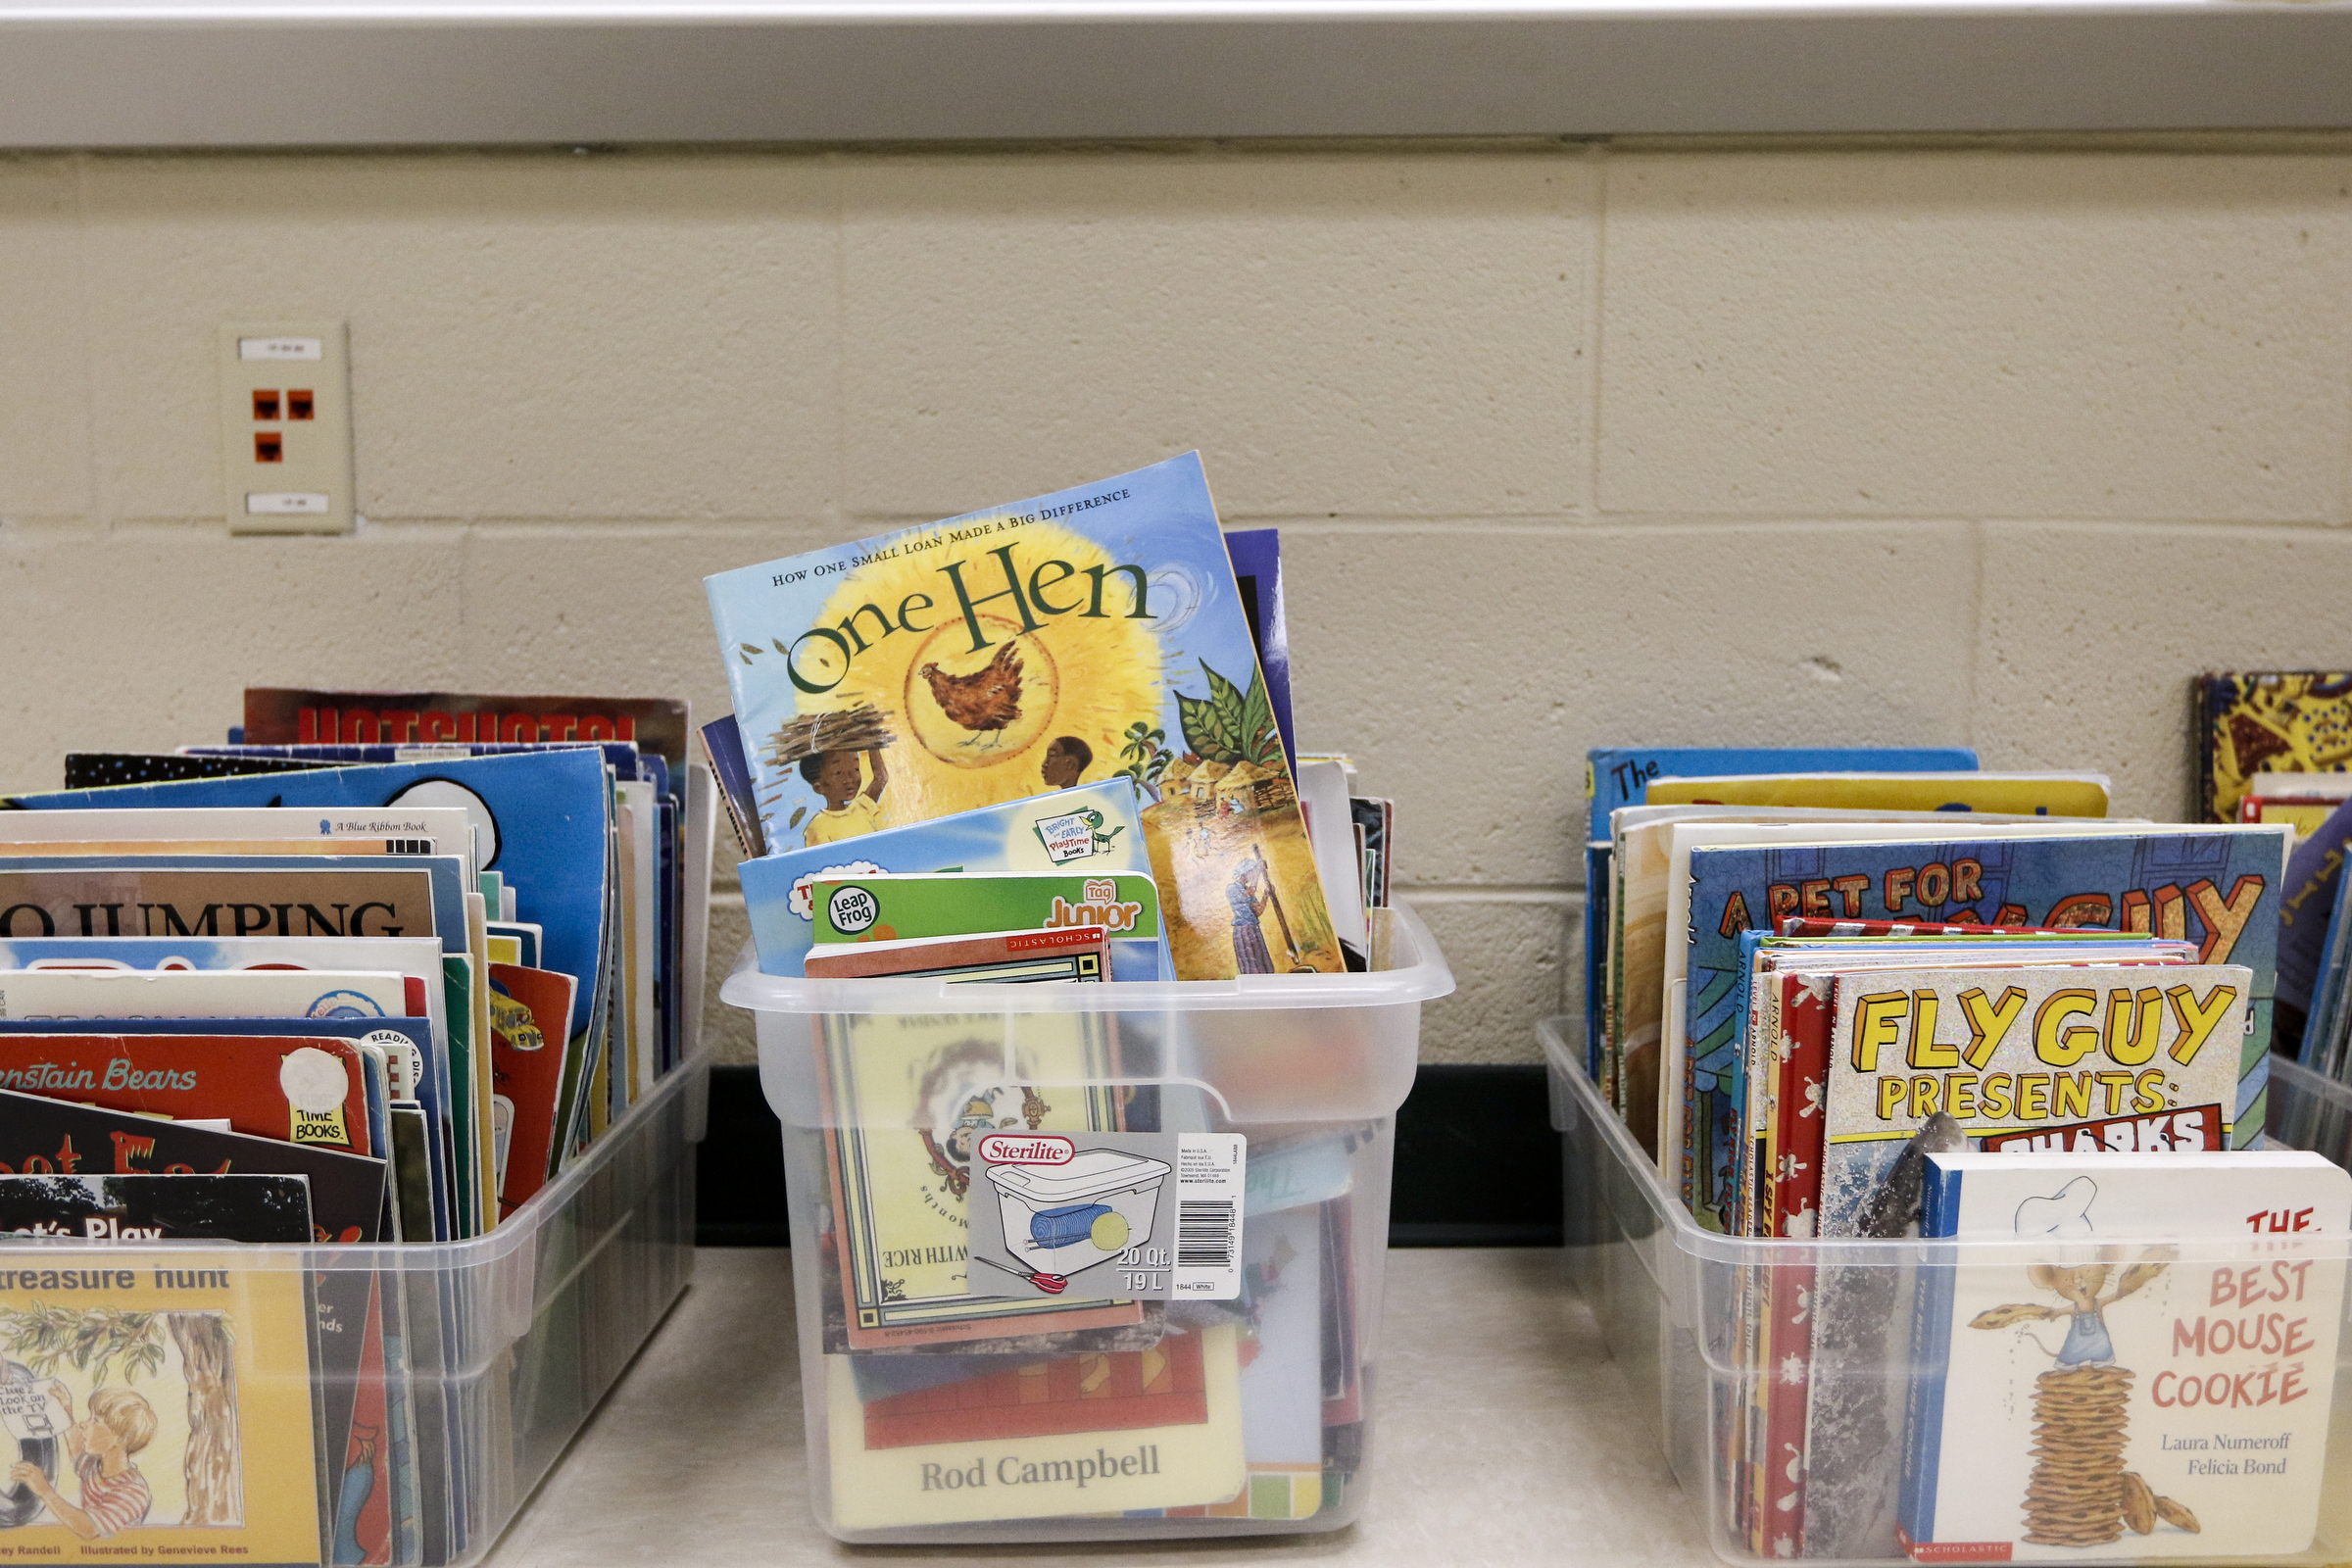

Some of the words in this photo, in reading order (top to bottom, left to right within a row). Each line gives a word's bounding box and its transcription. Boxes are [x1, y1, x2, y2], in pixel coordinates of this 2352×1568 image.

[772, 569, 808, 587] HOW
[813, 561, 847, 577] ONE
[852, 549, 900, 568] SMALL
[905, 537, 945, 555] LOAN
[949, 523, 993, 544] MADE
[996, 522, 1005, 532] A
[1009, 514, 1036, 528] BIG
[1040, 488, 1131, 521] DIFFERENCE
[786, 591, 935, 694] One
[936, 541, 1157, 654] Hen
[1611, 760, 1659, 801] The
[346, 821, 367, 832] Blue
[368, 821, 401, 832] Ribbon
[403, 821, 428, 832] Book
[1045, 817, 1074, 834] BRIGHT
[1061, 826, 1084, 839] EARLY
[834, 892, 867, 912] Leap
[1089, 886, 1110, 899] Tag
[1718, 890, 1753, 939] A
[1768, 873, 1869, 919] PET
[1885, 858, 1984, 912] FOR
[839, 906, 873, 926] Frog
[1046, 899, 1139, 928] Junior
[1009, 933, 1090, 949] SCHOLASTIC
[1736, 949, 1747, 1013] ARNOLD
[1769, 993, 1781, 1061] ARNOLD
[1851, 985, 2027, 1072] FLY
[2032, 984, 2237, 1066] GUY
[102, 1057, 197, 1091] Bears
[1877, 1069, 2179, 1121] PRESENTS:
[296, 1123, 340, 1139] BOOKS
[989, 1140, 1063, 1160] Sterilite
[1764, 1186, 1773, 1221] SPY
[883, 1248, 921, 1268] RICE
[925, 1244, 968, 1265] WITH
[1116, 1248, 1143, 1266] 20
[1146, 1248, 1171, 1267] Qt.
[154, 1263, 230, 1290] hunt
[1126, 1273, 1147, 1291] 19
[1152, 1273, 1163, 1291] L
[2209, 1258, 2314, 1308] BEST
[2172, 1313, 2315, 1357] MOUSE
[2151, 1362, 2309, 1409] COOKIE
[3, 1405, 24, 1414] the
[27, 1401, 46, 1413] TV
[2161, 1434, 2209, 1450] Laura
[2213, 1433, 2291, 1450] Numeroff
[921, 1460, 987, 1493] Rod
[997, 1445, 1160, 1490] Campbell
[2187, 1458, 2238, 1475] Felicia
[2243, 1458, 2287, 1475] Bond
[18, 1545, 61, 1555] Randell
[80, 1544, 137, 1555] Illustrated
[141, 1545, 154, 1557] by
[158, 1544, 217, 1555] Genevieve
[220, 1544, 249, 1555] Rees
[1925, 1543, 2009, 1555] SCHOLASTIC
